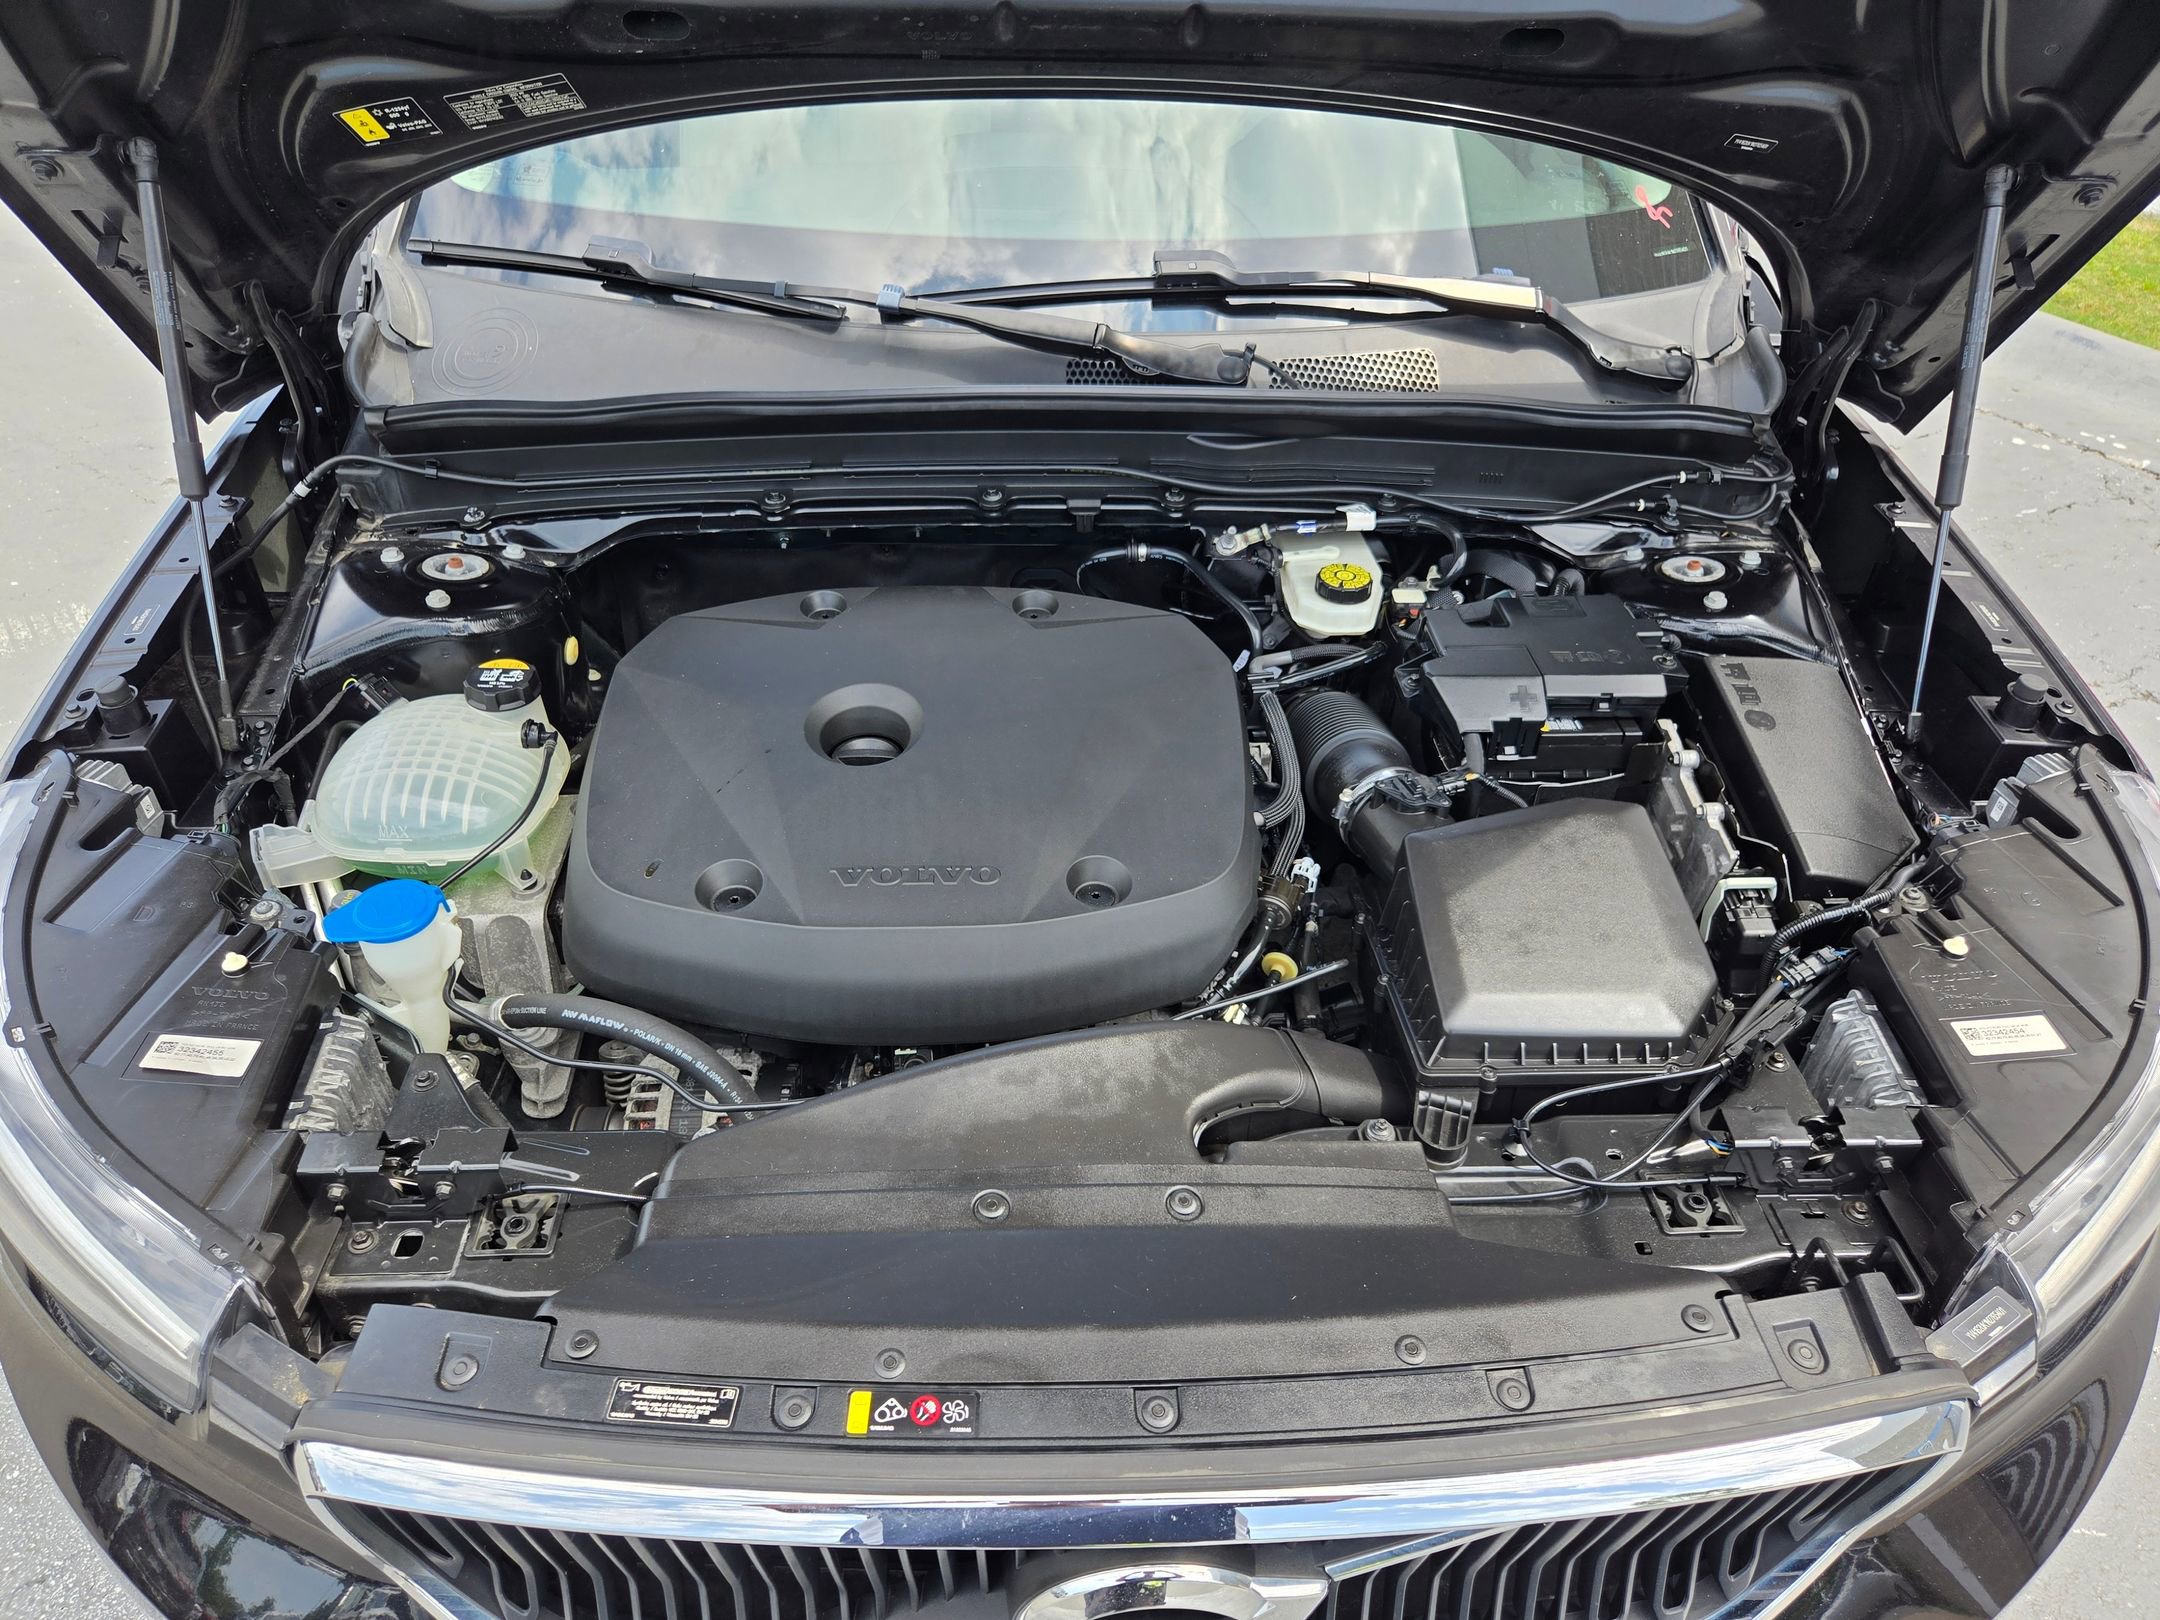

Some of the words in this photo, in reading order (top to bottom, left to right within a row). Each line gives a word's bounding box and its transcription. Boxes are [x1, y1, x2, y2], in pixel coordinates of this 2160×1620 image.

[379, 825, 409, 838] MAX
[395, 865, 428, 875] MIN
[829, 865, 1001, 887] VOLVO
[192, 986, 270, 1000] VOLVO
[225, 1022, 260, 1031] FRANCE
[578, 1012, 625, 1030] MAFLOW
[1981, 1028, 2026, 1037] 32342454
[177, 1046, 225, 1056] 32342455
